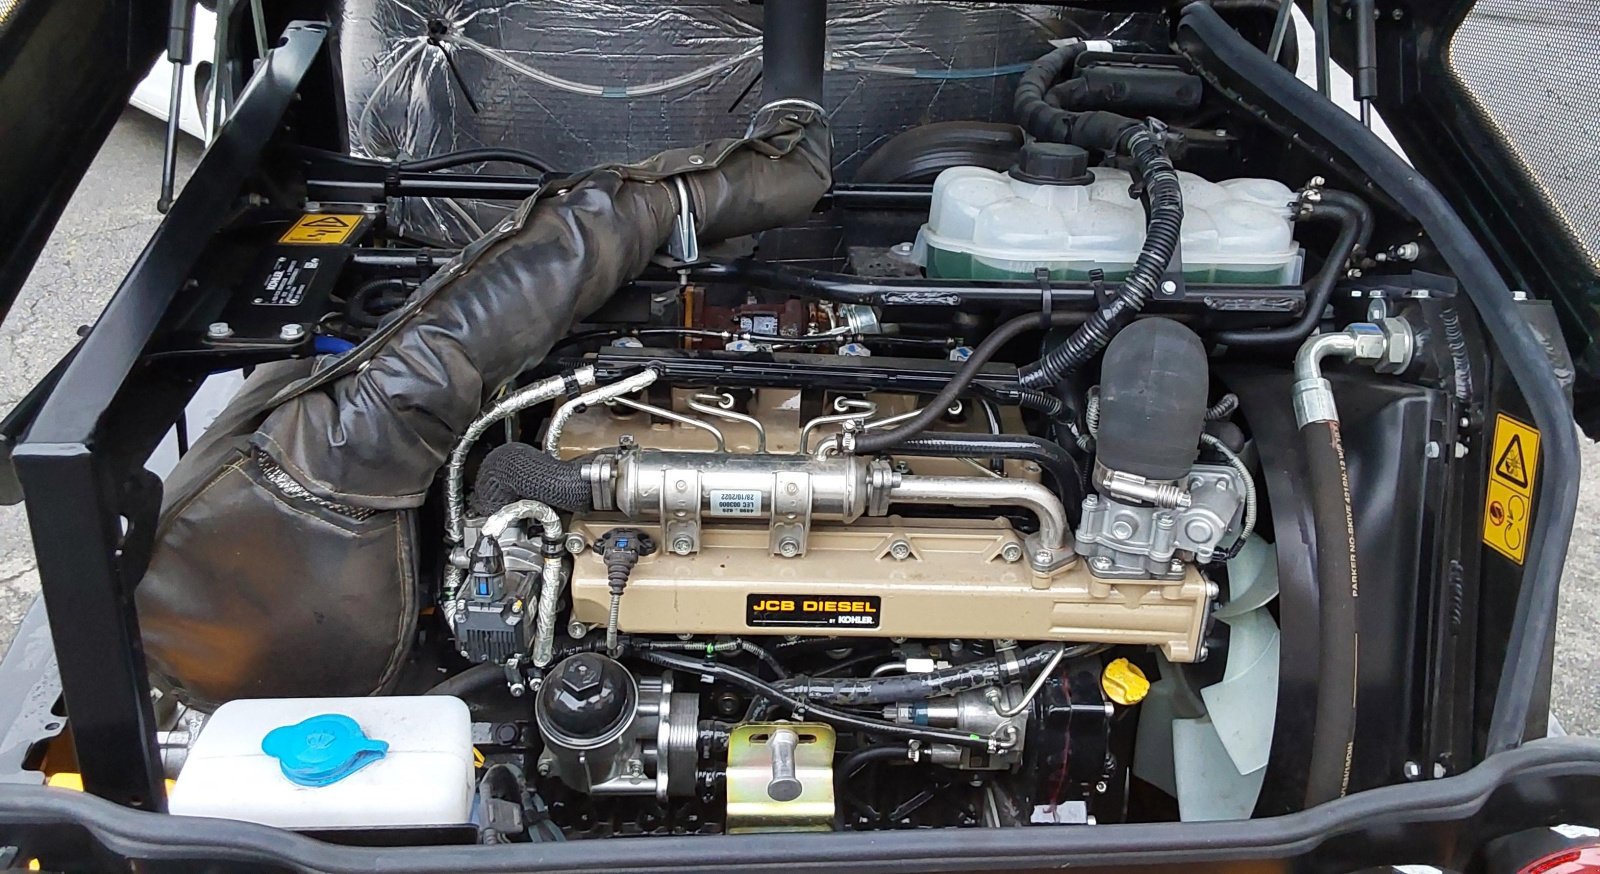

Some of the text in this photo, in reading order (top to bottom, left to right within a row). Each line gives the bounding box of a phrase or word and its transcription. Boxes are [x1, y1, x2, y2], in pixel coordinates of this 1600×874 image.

[1350, 554, 1358, 597] PARKER
[753, 600, 877, 612] JCB DIESEL
